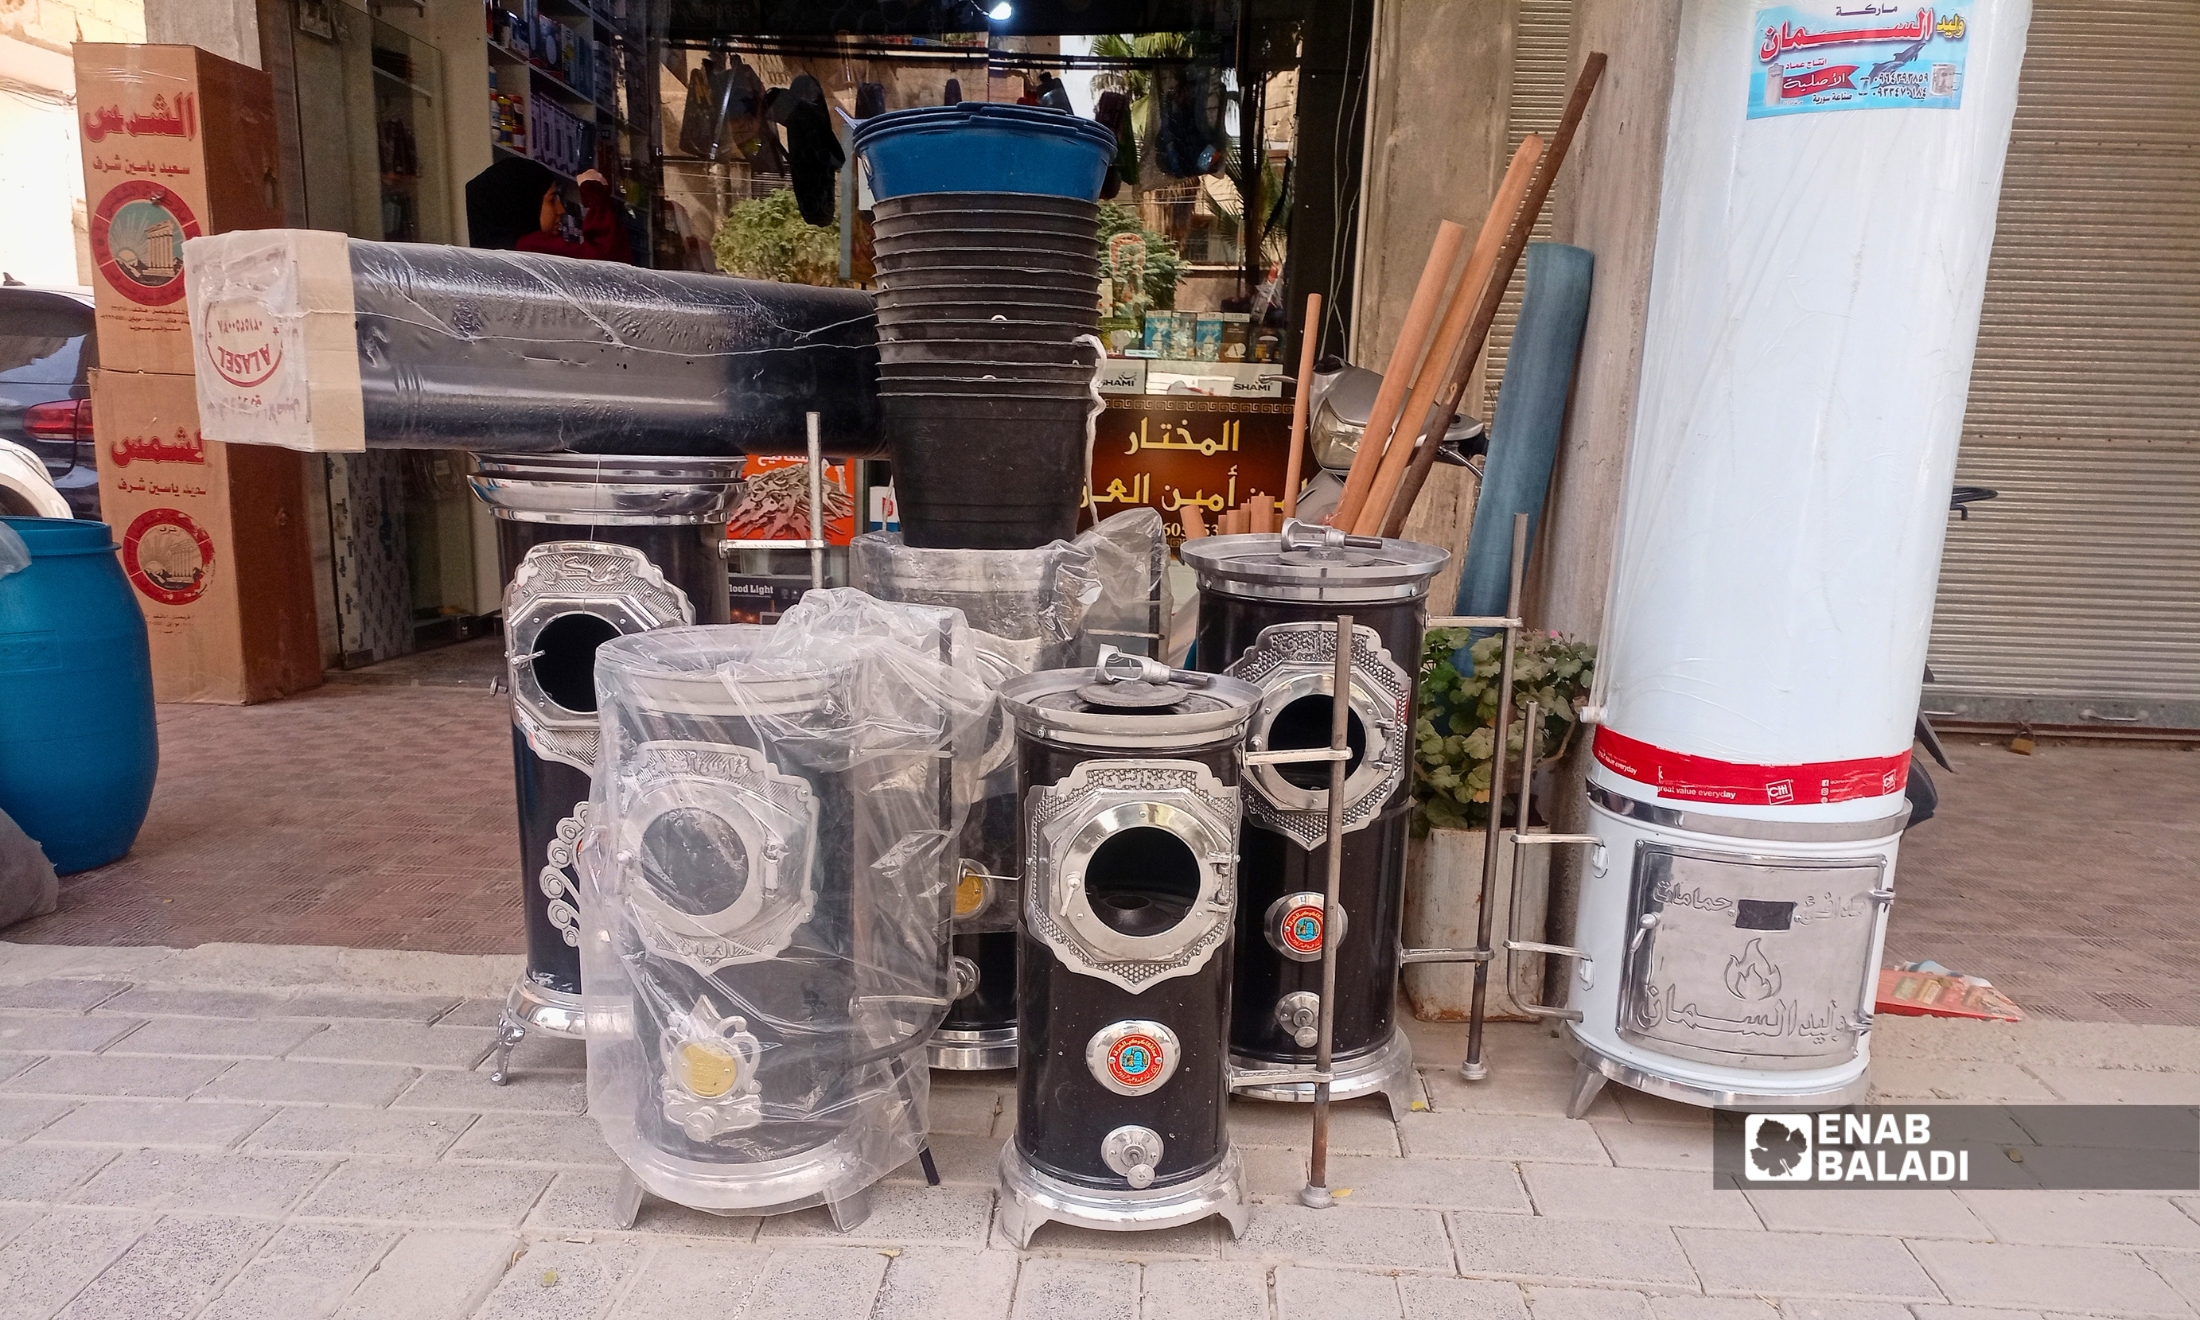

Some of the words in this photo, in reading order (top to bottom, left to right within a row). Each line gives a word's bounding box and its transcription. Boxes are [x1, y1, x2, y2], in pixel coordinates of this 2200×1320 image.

[1835, 4, 1898, 16] ماركة
[1759, 8, 1934, 62] السمان
[1936, 14, 1966, 38] وليد
[1783, 72, 1846, 91] الأصلية
[217, 343, 271, 375] ALASEL
[1233, 382, 1271, 392] SHAMI
[1124, 416, 1240, 456] المختار
[729, 584, 748, 593] lood
[750, 584, 774, 596] Light
[1676, 786, 1697, 796] value
[1698, 790, 1737, 800] everyday
[1637, 983, 1799, 1038] السمان
